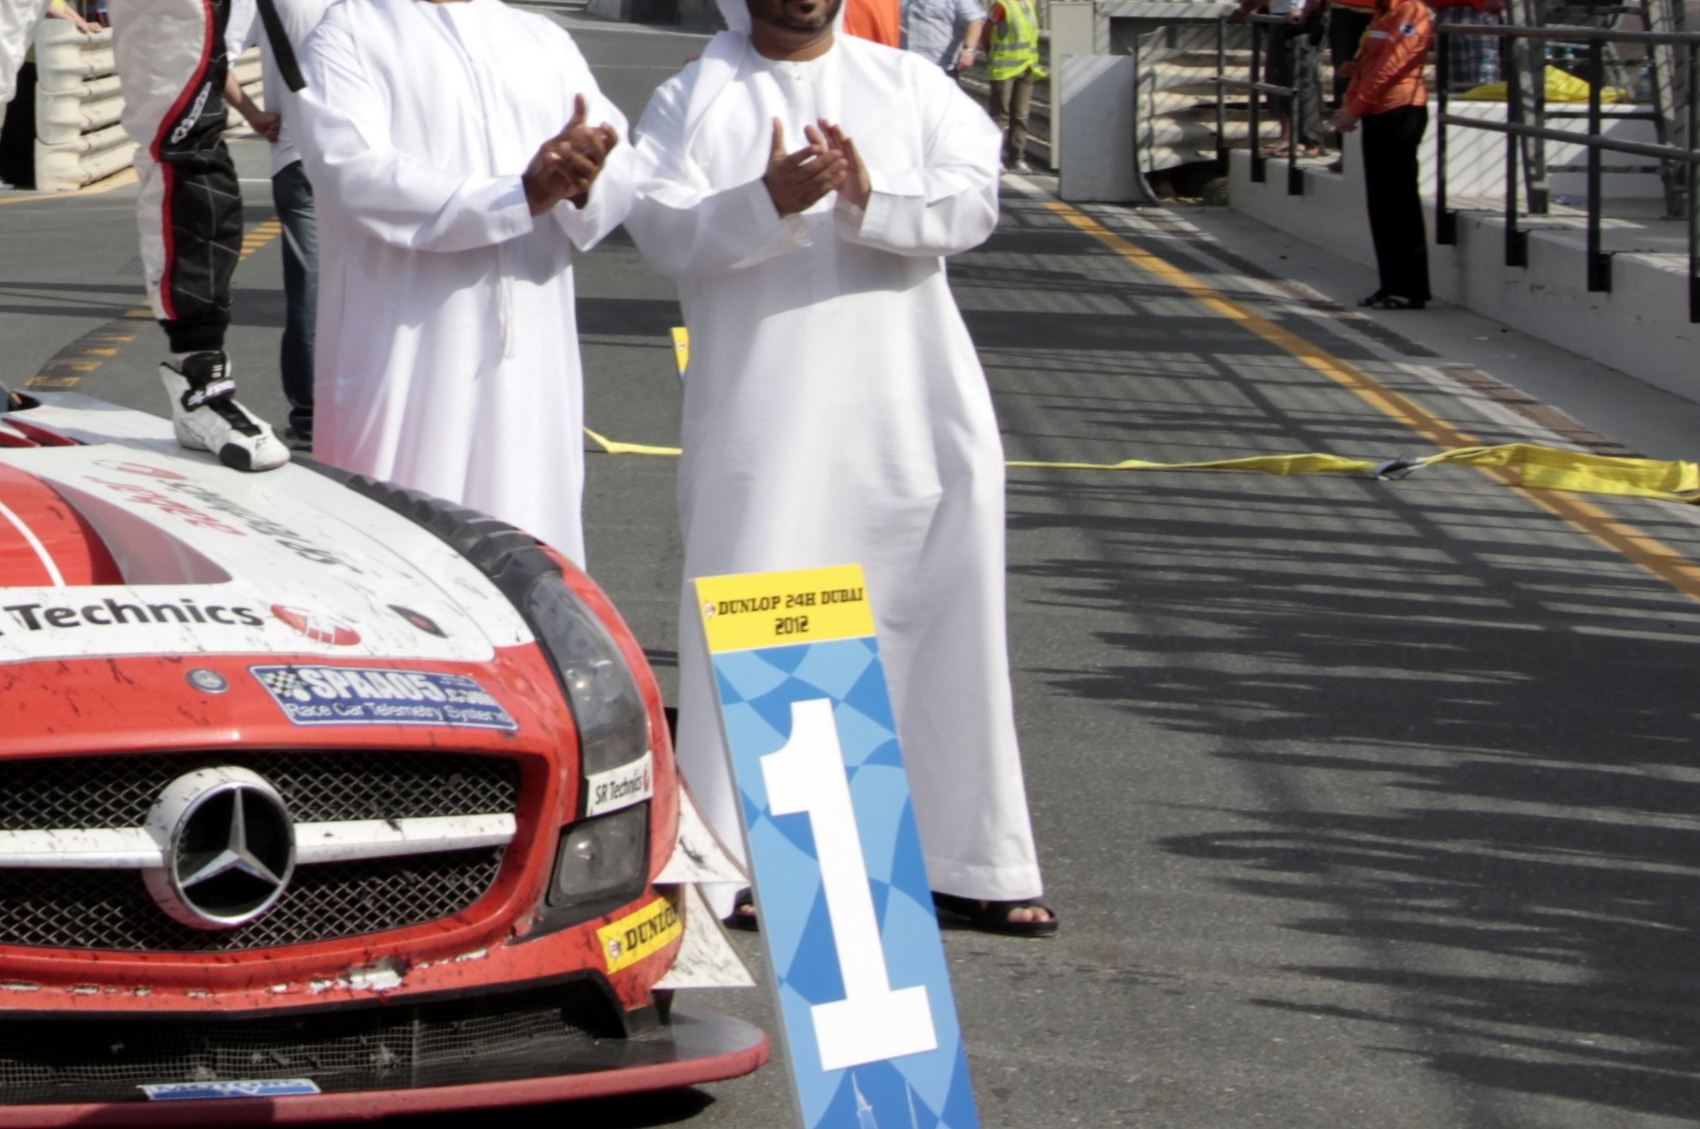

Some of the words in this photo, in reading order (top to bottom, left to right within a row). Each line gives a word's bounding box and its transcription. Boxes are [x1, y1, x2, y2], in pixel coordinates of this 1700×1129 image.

[3, 596, 265, 633] Technics
[717, 593, 781, 617] DUNLOP
[784, 591, 817, 608] 24H
[819, 586, 864, 607] DUBAI
[774, 615, 810, 636] 2012
[282, 703, 333, 719] Race
[332, 702, 365, 717] Car
[364, 701, 443, 721] Telemetry
[594, 783, 608, 806] SR
[608, 775, 644, 801] Technics
[759, 697, 938, 1072] 1
